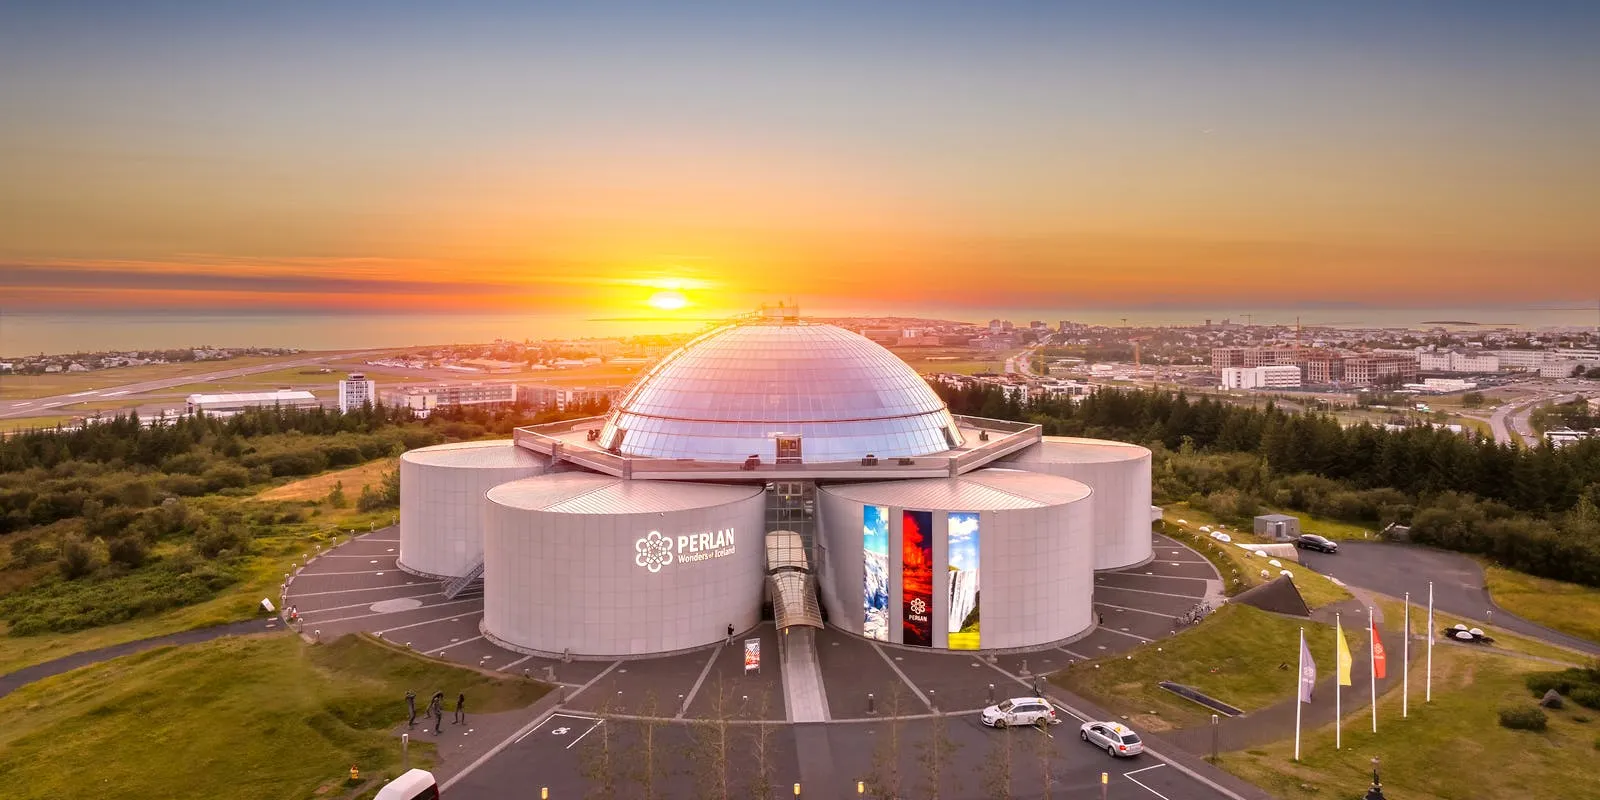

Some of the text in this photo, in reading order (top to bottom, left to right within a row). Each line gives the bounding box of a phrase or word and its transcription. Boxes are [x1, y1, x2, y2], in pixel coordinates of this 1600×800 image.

[678, 528, 734, 553] PERLAN
[678, 552, 709, 564] Wonders
[714, 545, 736, 558] Iceland
